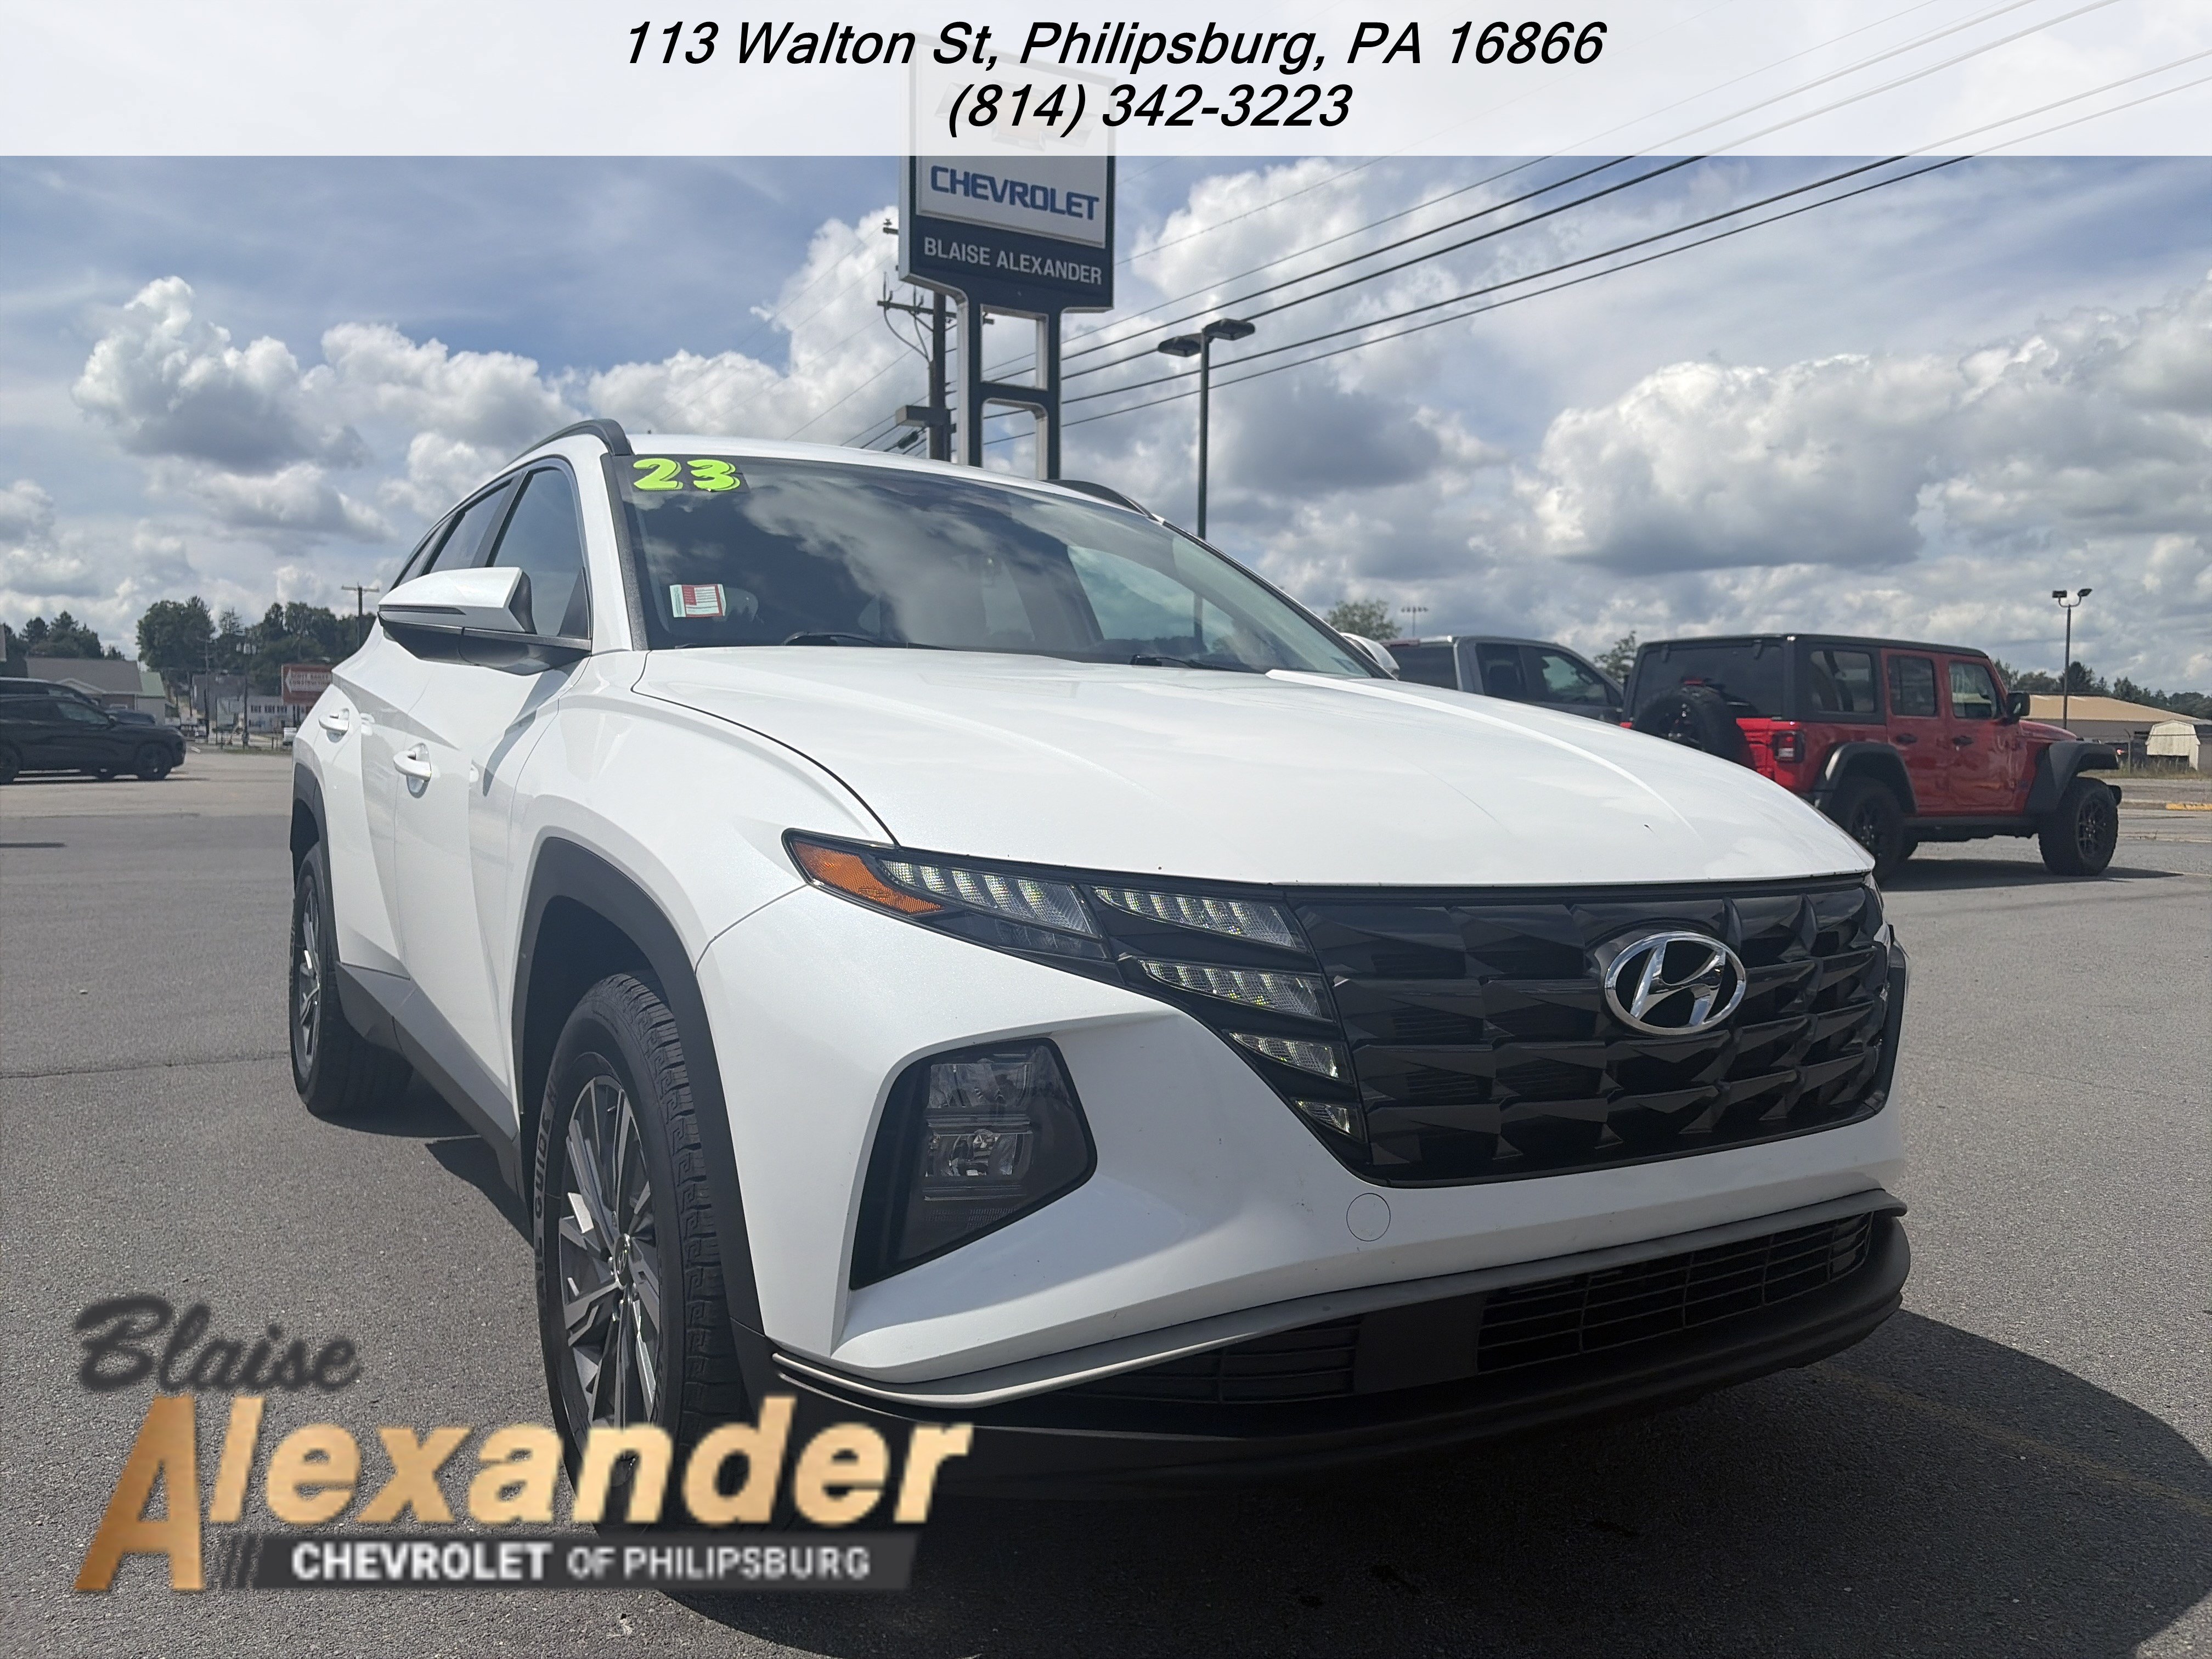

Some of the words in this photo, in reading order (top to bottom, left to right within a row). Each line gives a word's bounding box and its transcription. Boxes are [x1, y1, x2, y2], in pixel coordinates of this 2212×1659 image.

[930, 165, 1099, 220] CHEVROLET
[923, 236, 991, 266] BLAISE
[996, 250, 1102, 285] ALEXANDER
[633, 458, 741, 492] 23
